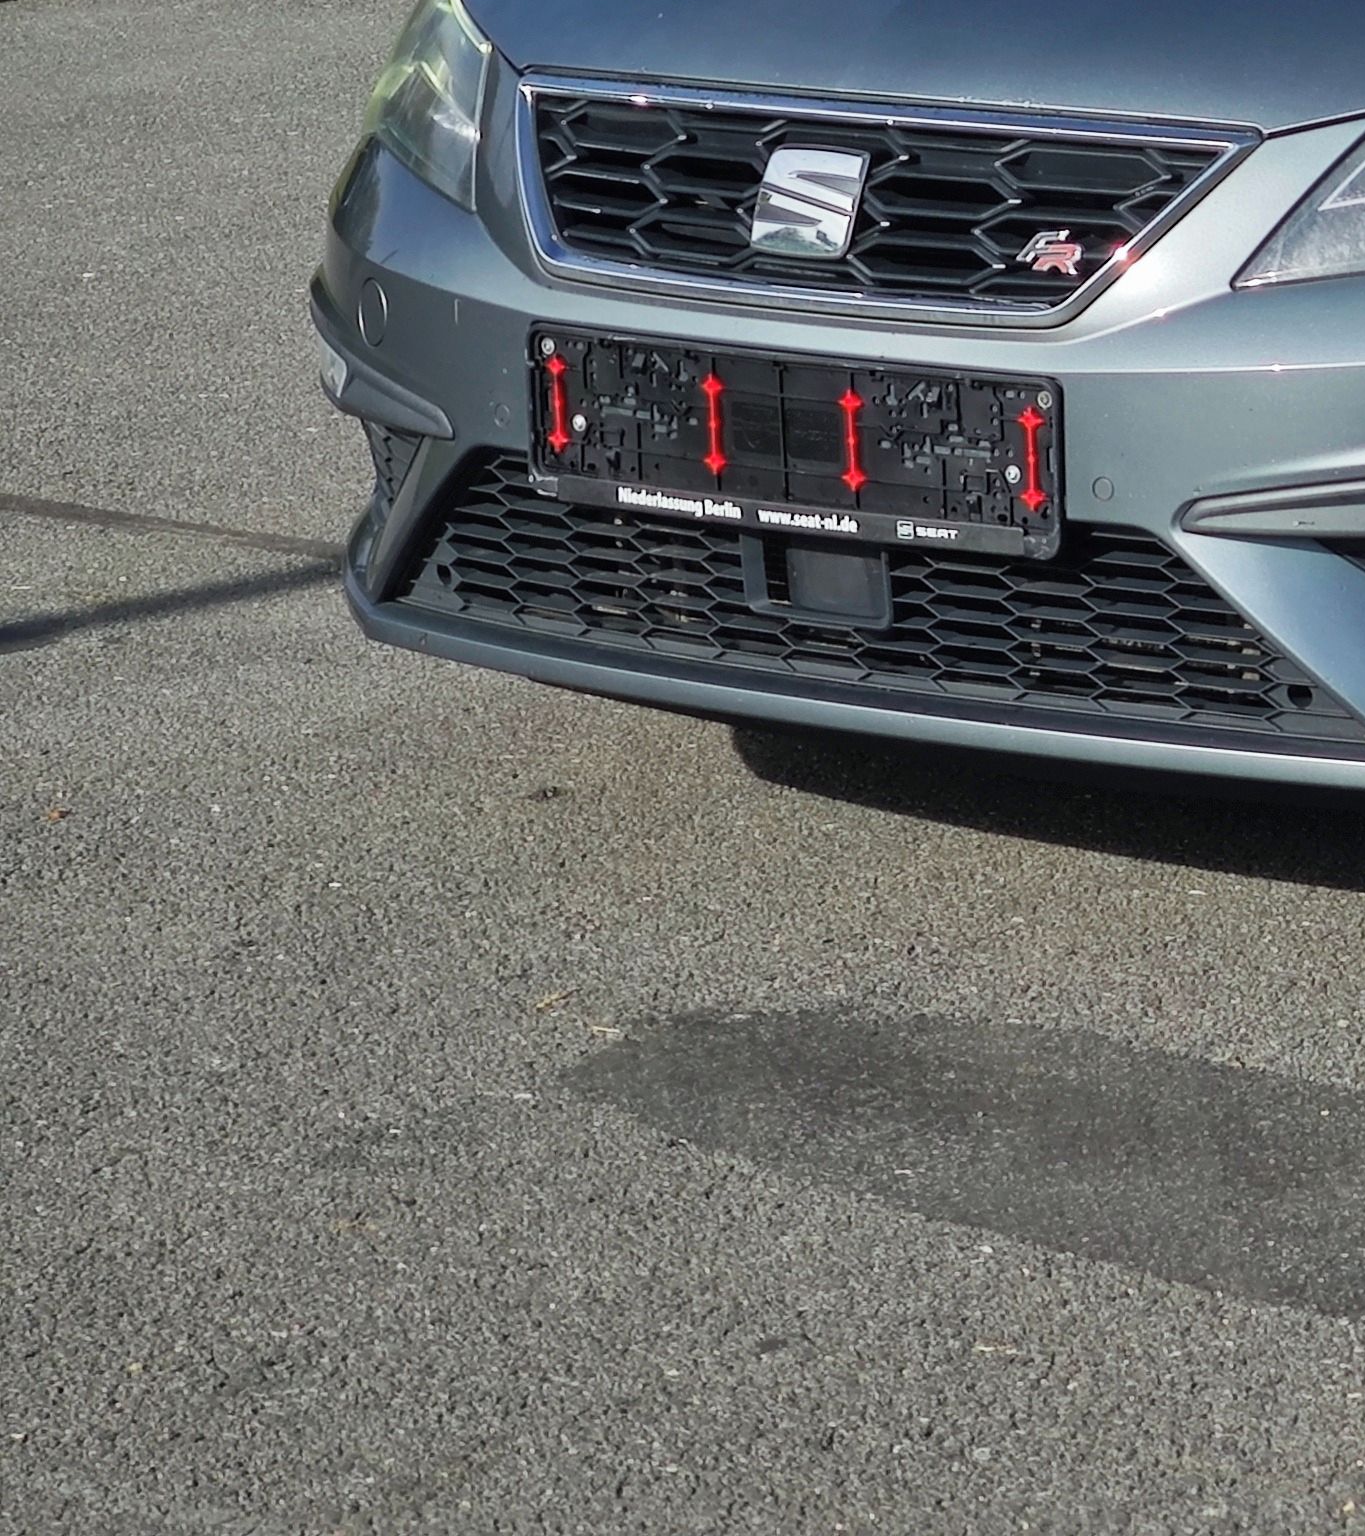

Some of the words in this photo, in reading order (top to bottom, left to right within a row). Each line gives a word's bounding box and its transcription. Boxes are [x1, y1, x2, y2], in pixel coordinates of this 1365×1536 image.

[618, 486, 703, 518] Niederlassung
[703, 498, 742, 520] Berlin
[757, 509, 859, 534] www.seat-nl.de
[915, 526, 959, 540] SEAT
